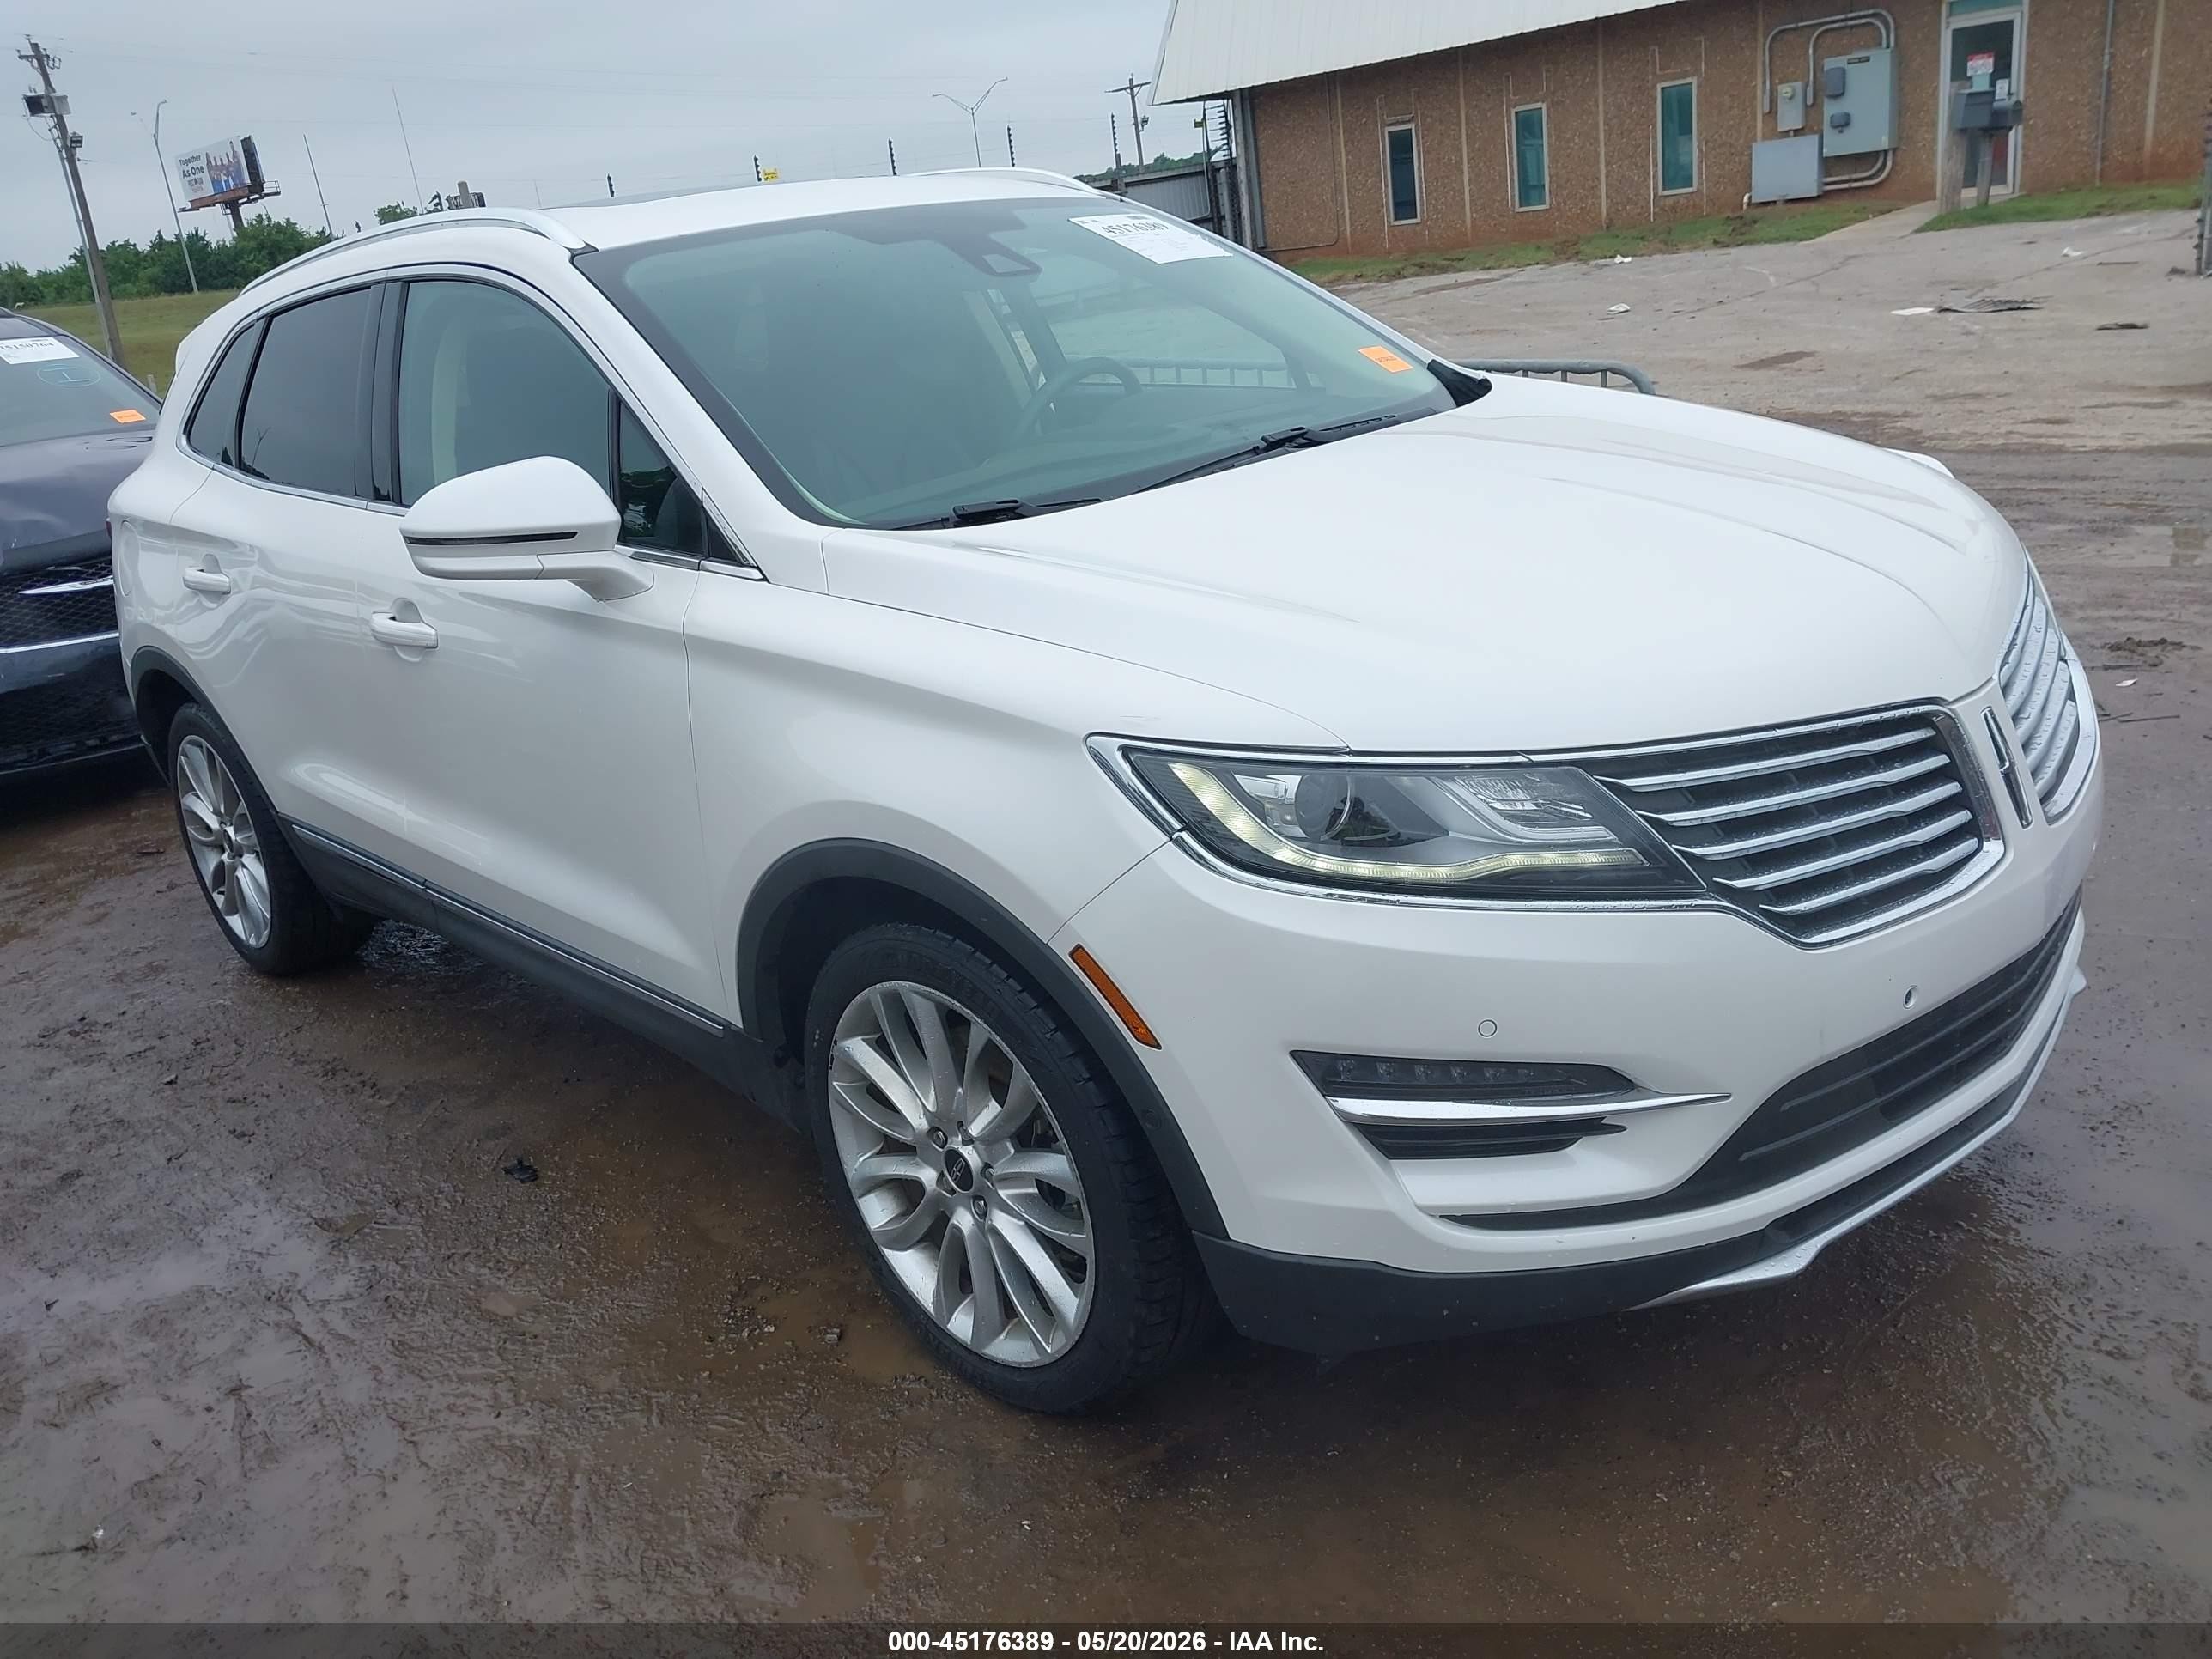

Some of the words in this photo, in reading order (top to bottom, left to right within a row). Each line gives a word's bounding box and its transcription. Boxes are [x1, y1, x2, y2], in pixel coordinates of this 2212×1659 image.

[179, 155, 201, 166] Together
[182, 169, 191, 179] As
[191, 166, 204, 176] One
